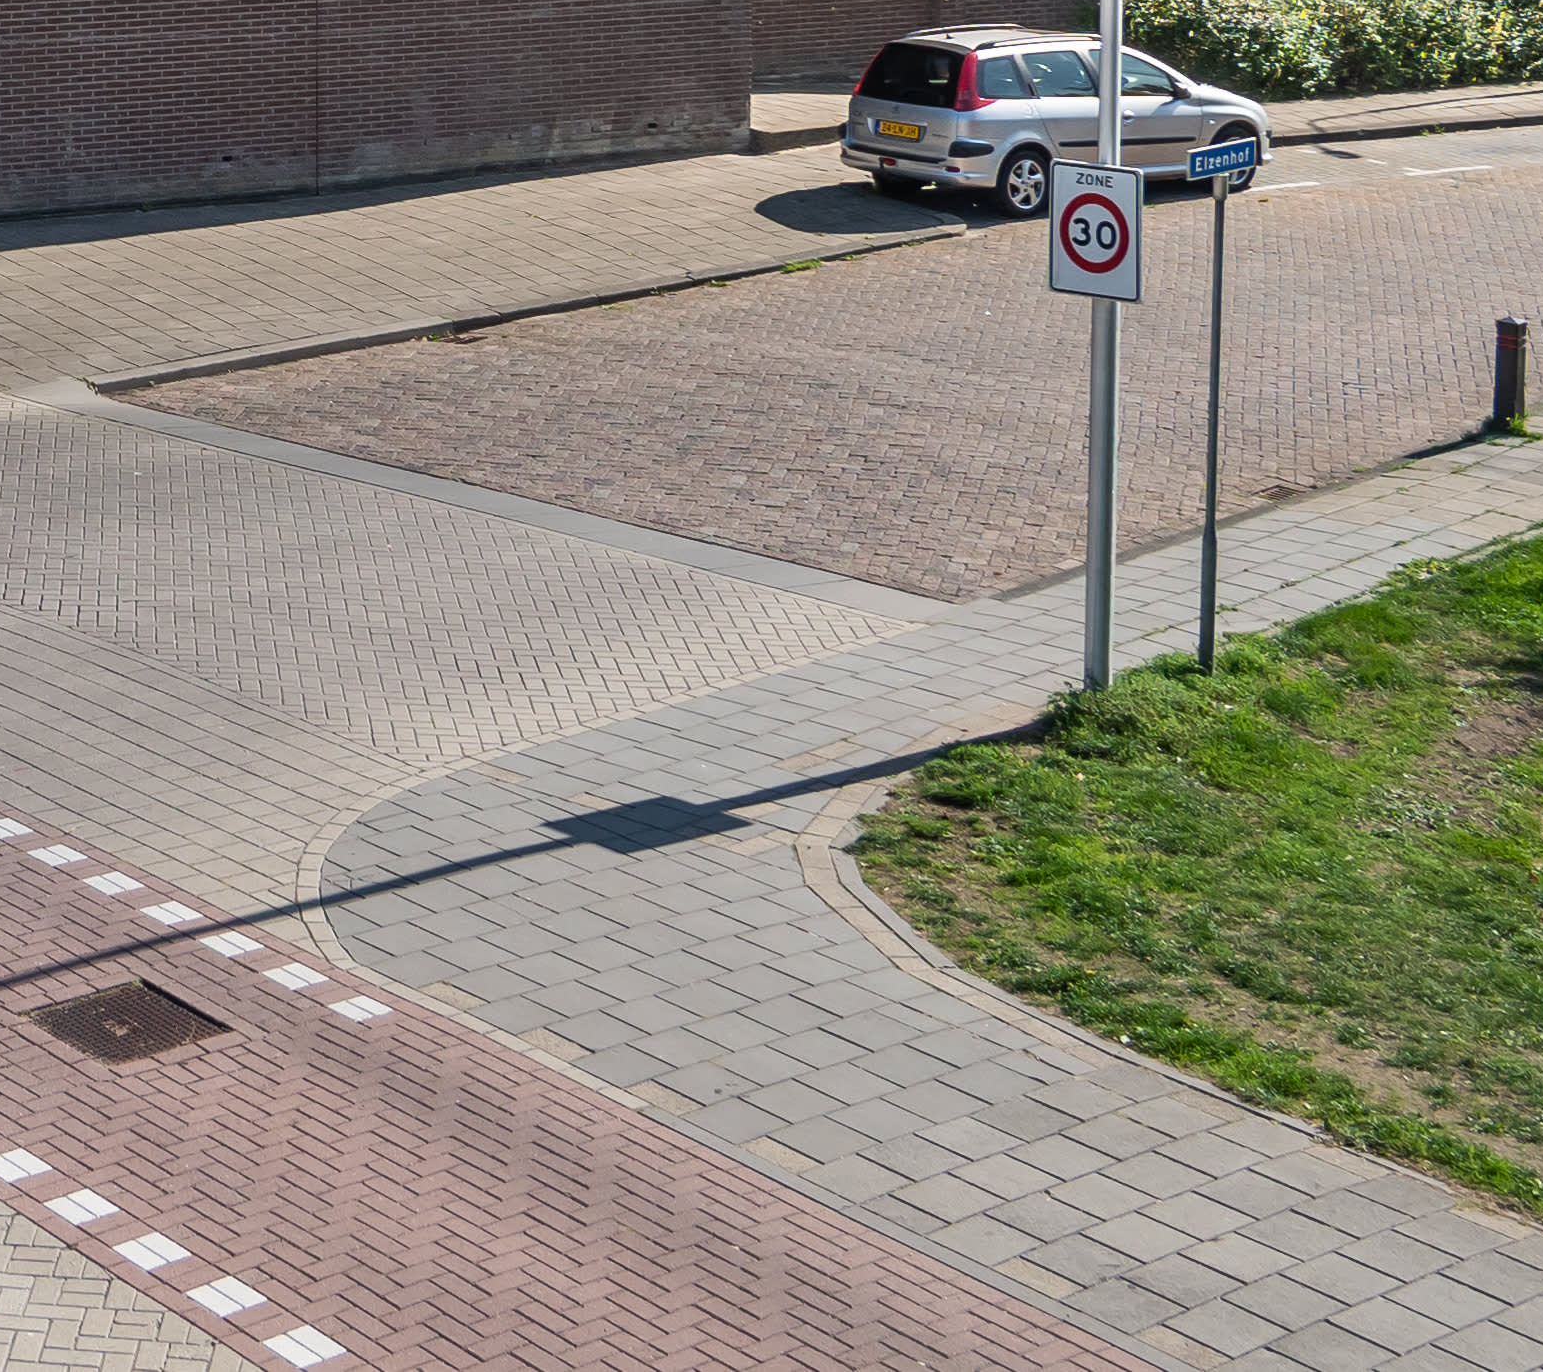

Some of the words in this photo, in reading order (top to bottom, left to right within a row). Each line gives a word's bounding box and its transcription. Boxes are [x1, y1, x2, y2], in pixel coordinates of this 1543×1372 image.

[1195, 146, 1251, 173] Elzenhof
[1075, 171, 1114, 189] ZONE
[1071, 216, 1117, 250] 30
